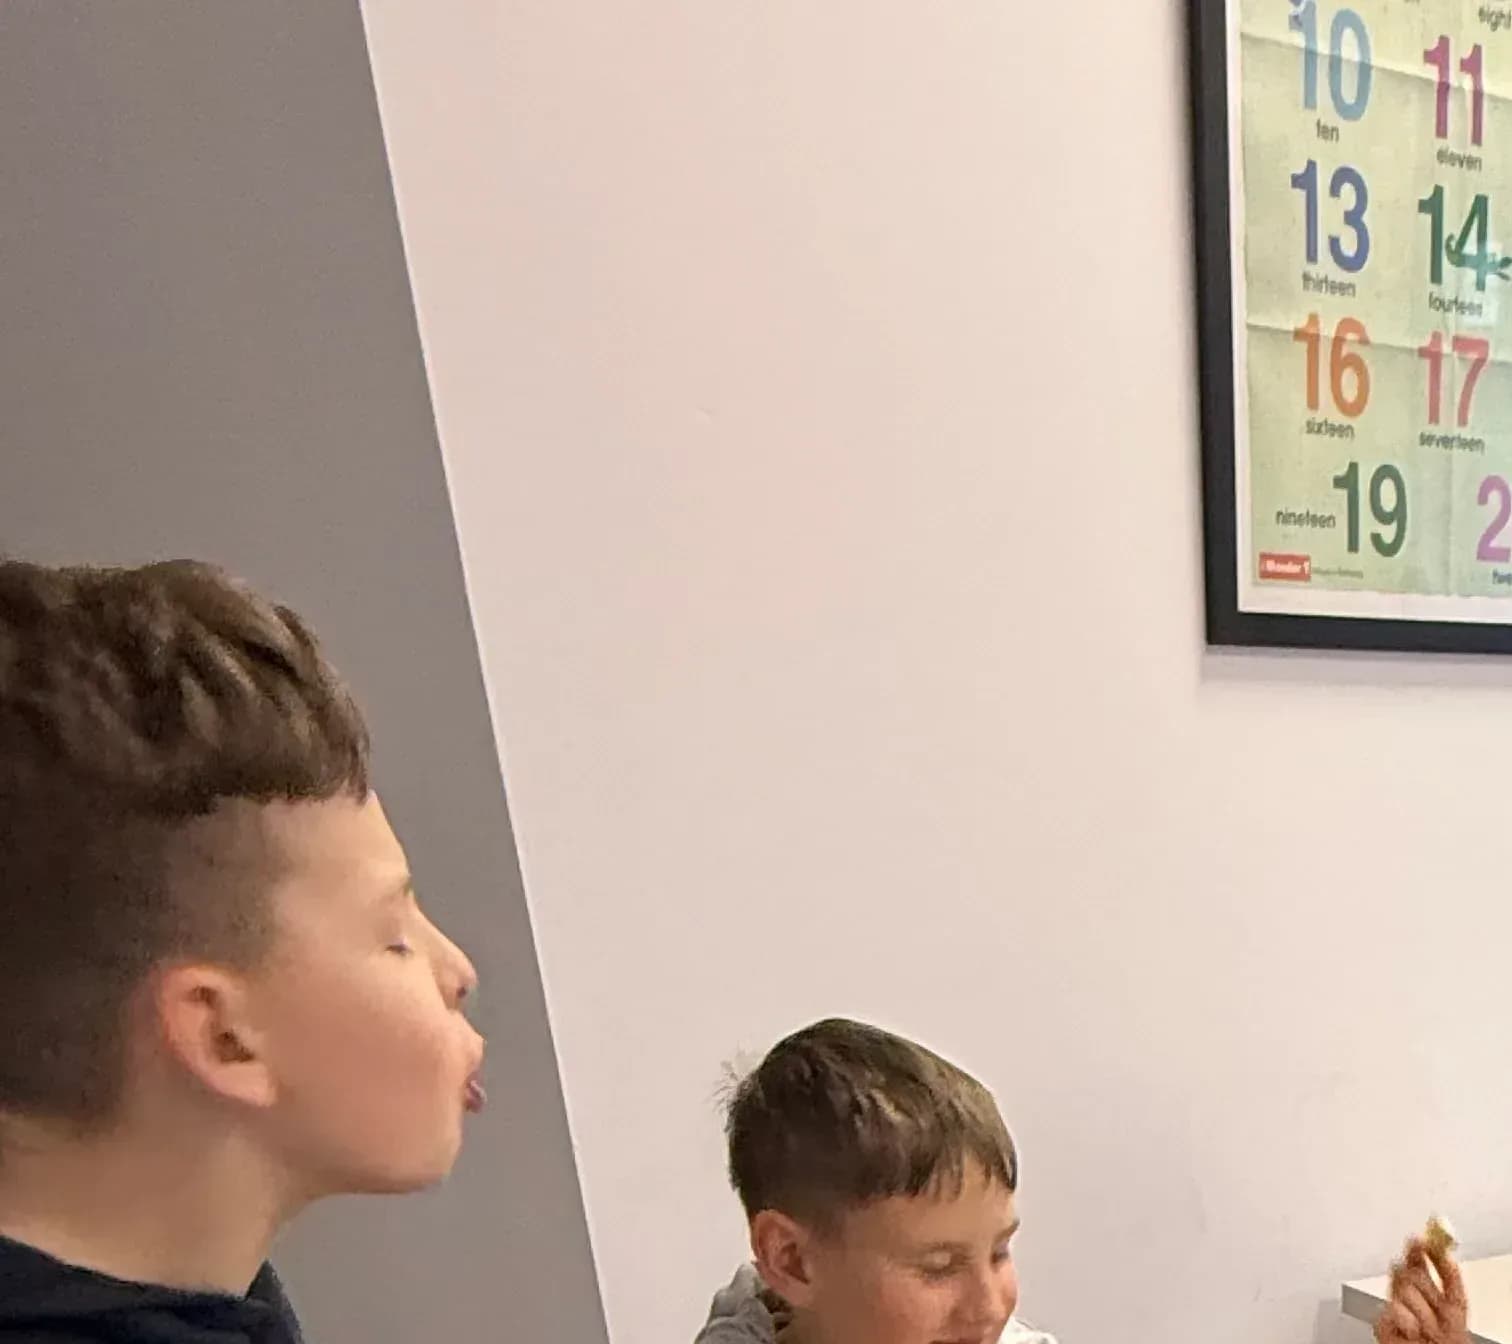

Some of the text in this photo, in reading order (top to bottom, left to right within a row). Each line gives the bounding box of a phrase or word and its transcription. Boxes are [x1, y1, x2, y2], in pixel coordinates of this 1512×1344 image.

[1288, 0, 1372, 122] 10
[1423, 35, 1483, 147] 11
[1316, 119, 1340, 143] ten
[1437, 149, 1483, 172] eleven
[1290, 159, 1370, 273] 13
[1418, 184, 1490, 292] 14
[1302, 272, 1356, 299] thirteen
[1293, 313, 1372, 418] 16
[1417, 331, 1491, 428] 17
[1305, 418, 1354, 440] sixteen
[1419, 431, 1485, 453] seventeen
[1275, 461, 1408, 557] nineteen 19
